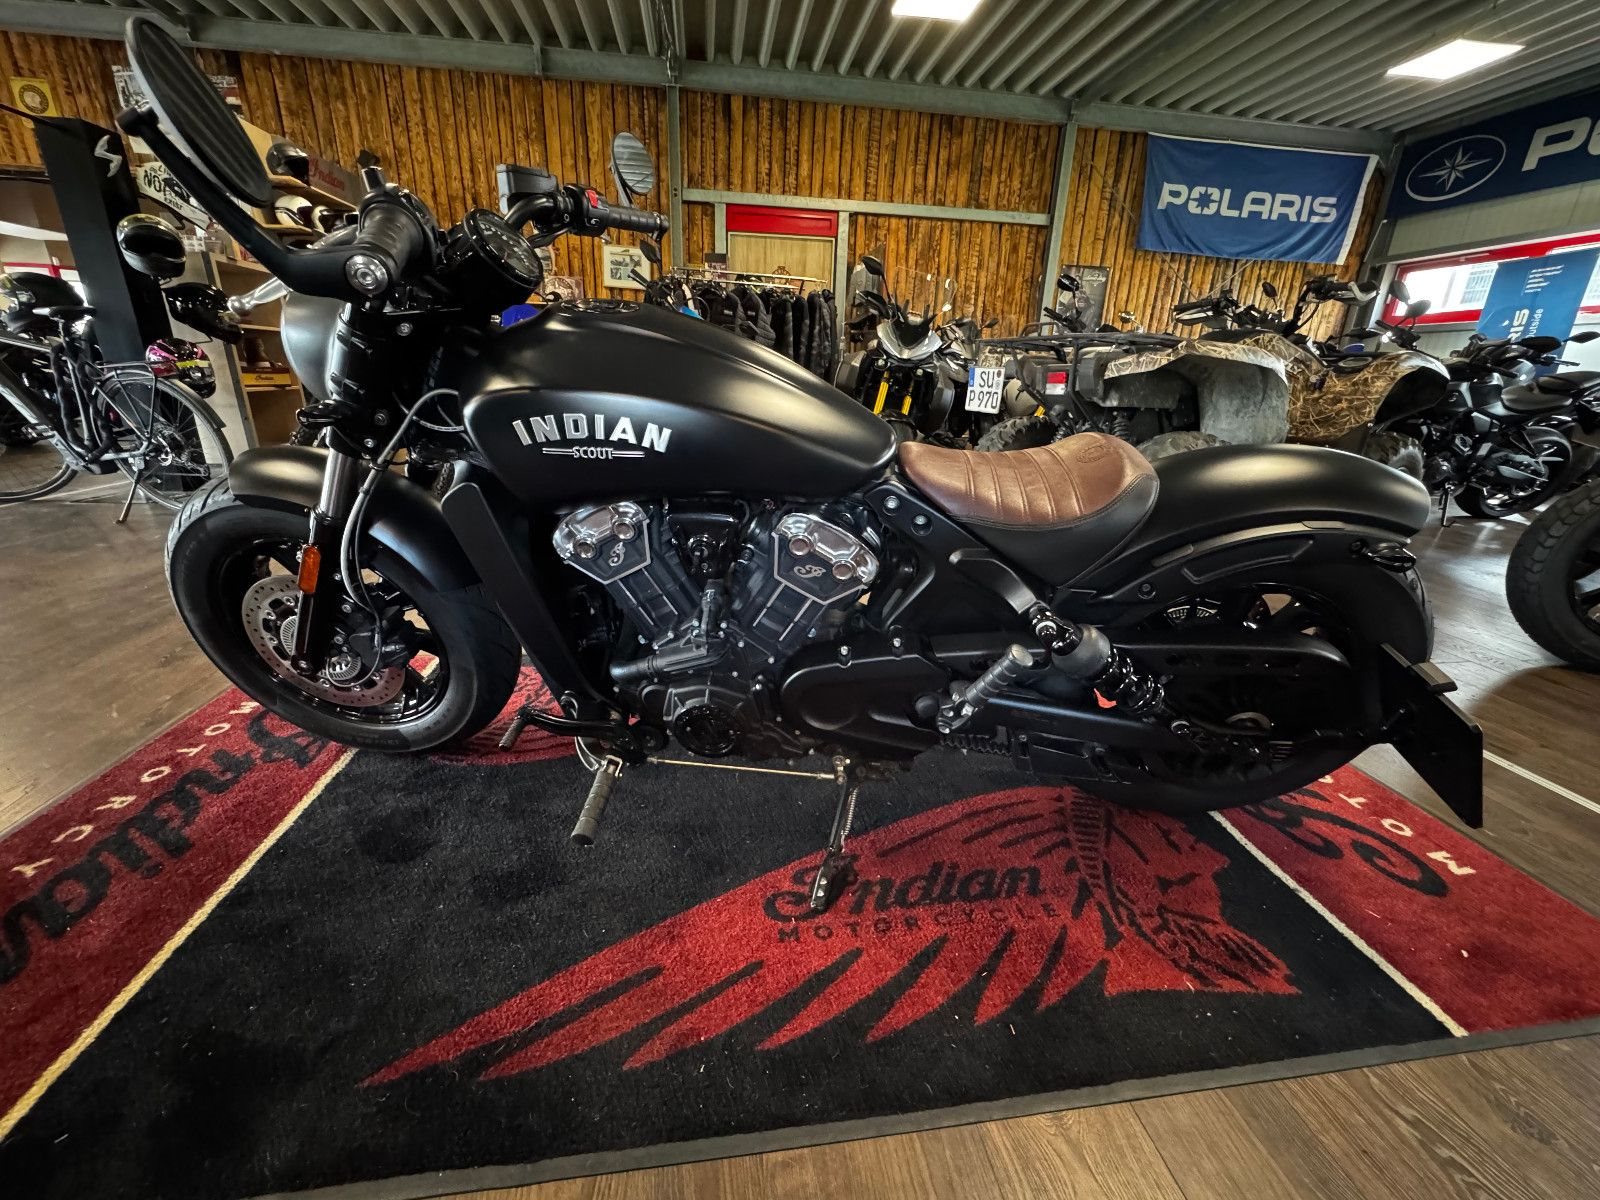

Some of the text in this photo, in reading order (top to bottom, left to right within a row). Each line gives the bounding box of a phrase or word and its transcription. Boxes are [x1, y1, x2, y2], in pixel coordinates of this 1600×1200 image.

[1157, 181, 1338, 224] POLARIS
[967, 389, 999, 410] P 970
[978, 370, 996, 388] SU
[512, 412, 673, 454] INDIAN
[572, 446, 614, 460] SCOUT
[762, 854, 1044, 923] Indian
[777, 902, 1061, 944] MOTORCYCLE
